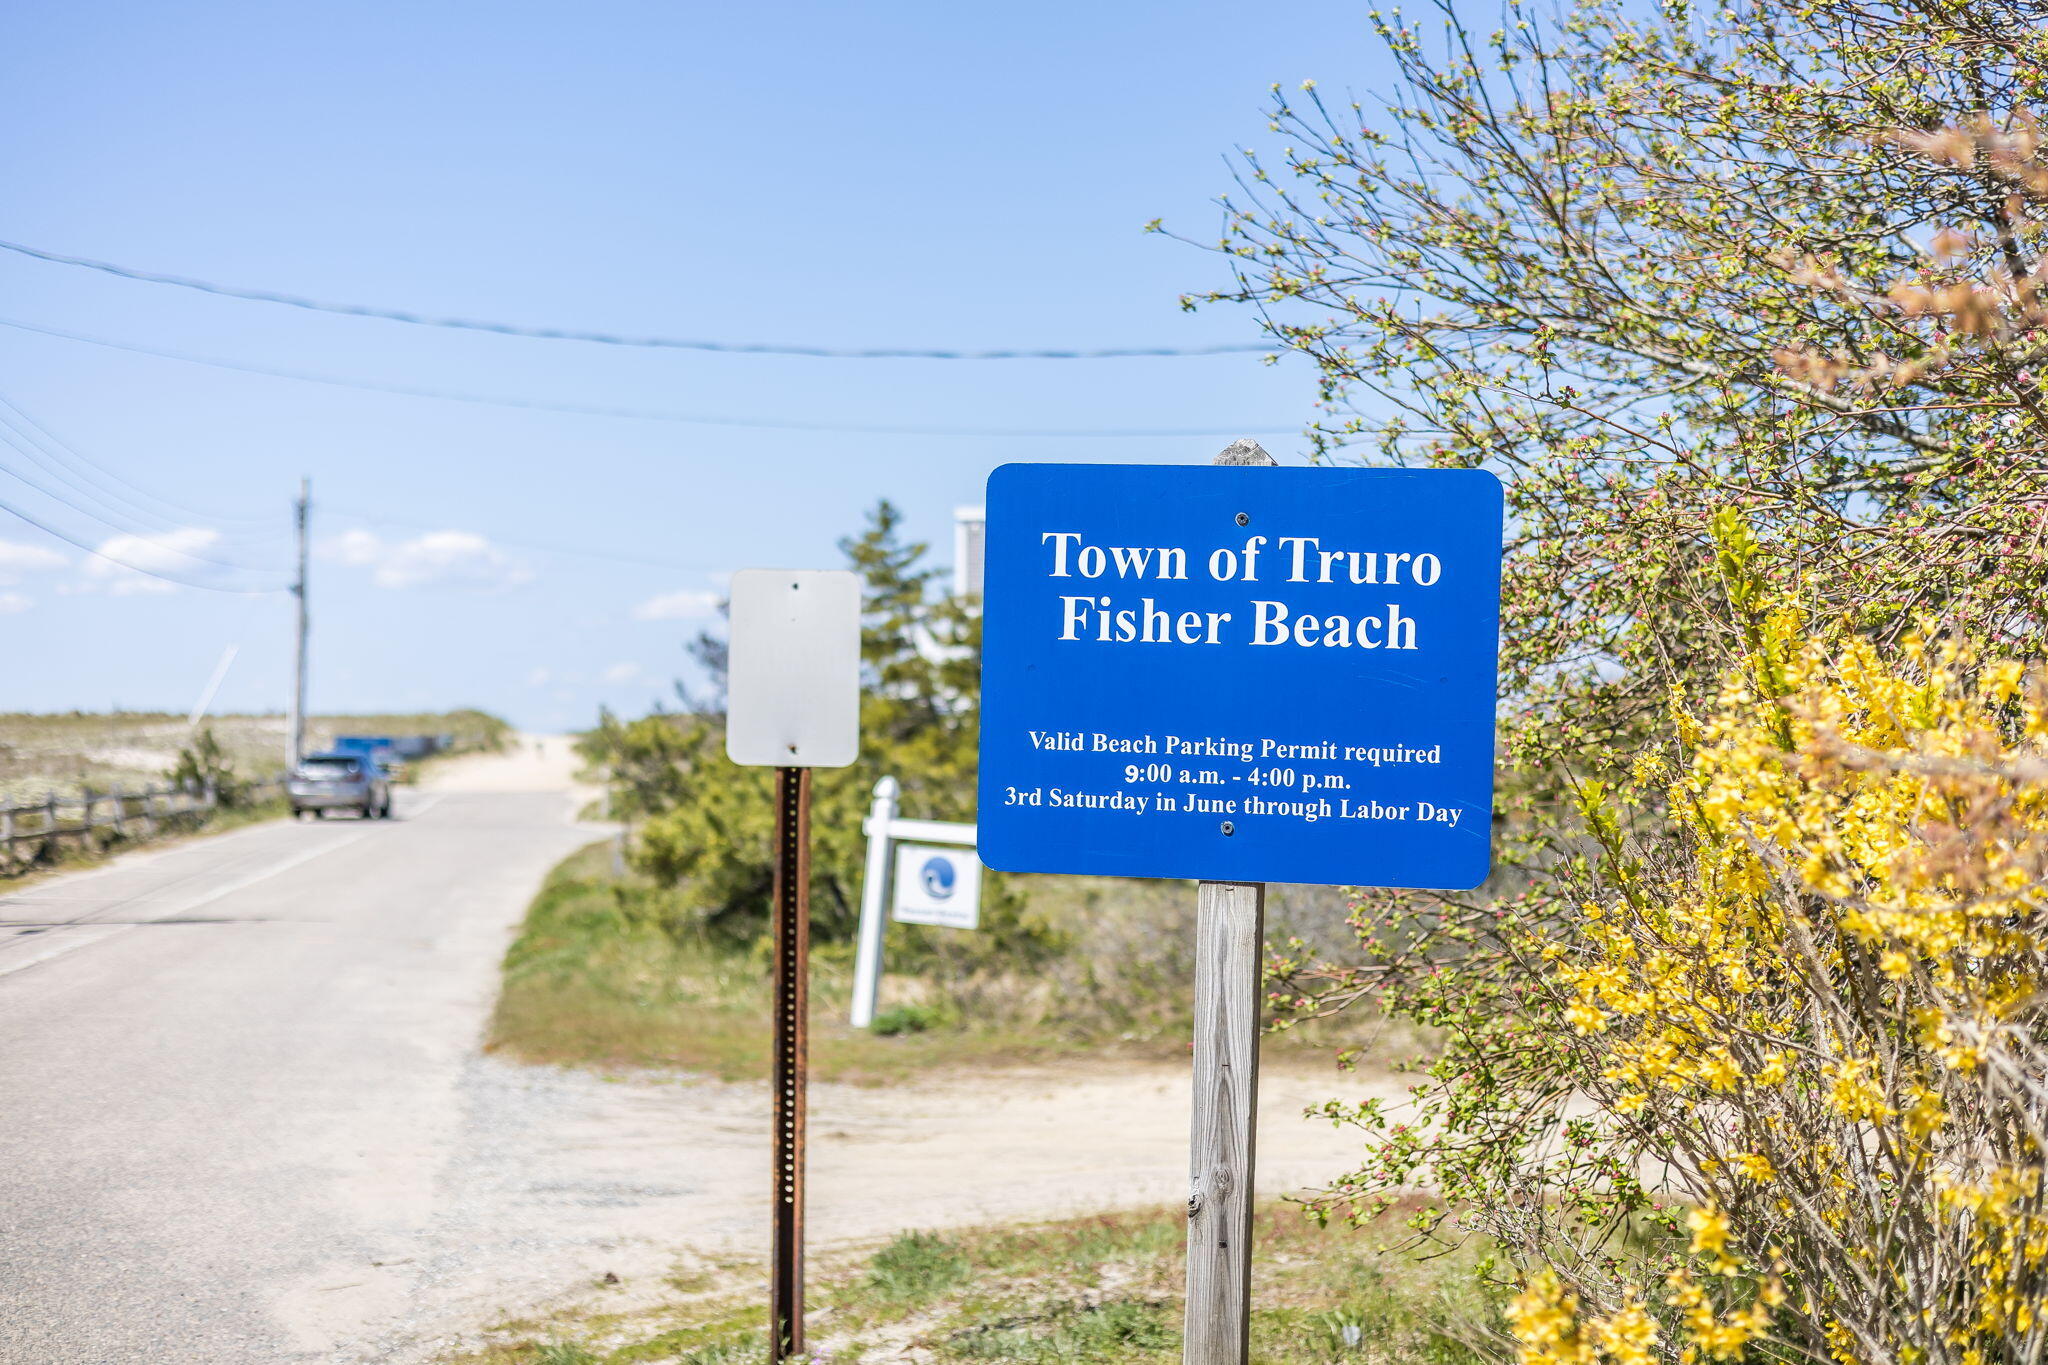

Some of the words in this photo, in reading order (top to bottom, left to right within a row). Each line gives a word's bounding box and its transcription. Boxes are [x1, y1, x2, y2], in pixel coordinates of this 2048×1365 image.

[1042, 532, 1188, 580] Town
[1209, 536, 1267, 582] of
[1279, 537, 1441, 586] Truro
[1058, 596, 1231, 645] Fisher
[1249, 600, 1418, 650] Beach
[1028, 731, 1084, 752] Valid
[1091, 733, 1157, 754] Beach
[1165, 735, 1253, 763] Parking
[1261, 739, 1338, 760] Permit
[1345, 745, 1440, 768] required
[1125, 764, 1171, 784] 9:00
[1180, 768, 1226, 785] a.m.
[1248, 767, 1294, 787] 4:00
[1302, 774, 1351, 794] p.m.
[1005, 786, 1041, 807] 3rd
[1050, 788, 1149, 816] Saturday
[1156, 791, 1176, 811] in
[1183, 794, 1236, 814] June
[1244, 796, 1331, 822] through
[1340, 799, 1409, 821] Labor
[1417, 802, 1462, 828] Day
